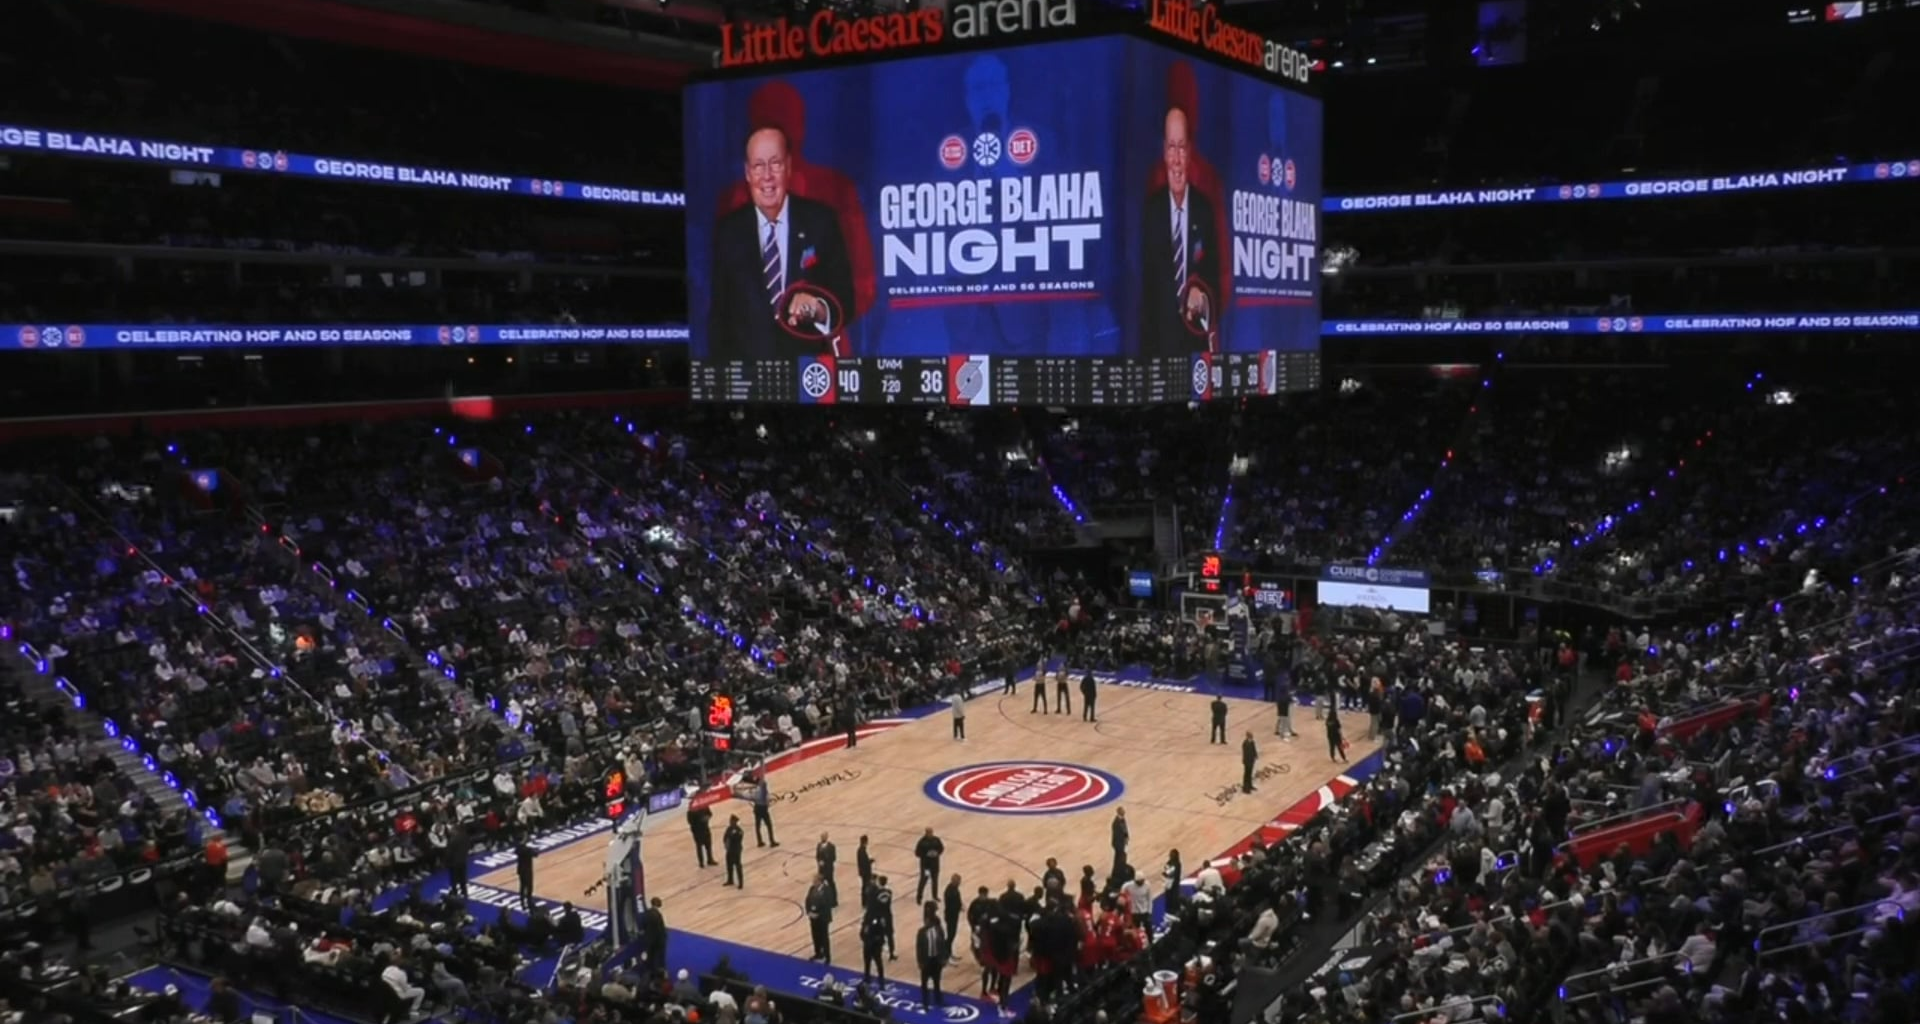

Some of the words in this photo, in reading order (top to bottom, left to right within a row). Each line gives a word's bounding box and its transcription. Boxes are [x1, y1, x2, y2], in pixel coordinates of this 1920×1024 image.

[721, 18, 805, 68] Little
[809, 8, 944, 57] Caesars
[952, 0, 1076, 39] arena
[1150, 0, 1199, 44] Little
[1201, 3, 1264, 68] Caesars
[1264, 40, 1309, 82] arena
[47, 132, 136, 157] BLAHA
[140, 141, 214, 163] NIGHT
[314, 160, 394, 180] GEORGE
[398, 167, 458, 187] BLAHA
[461, 175, 512, 192] NIGHT
[1625, 180, 1709, 196] GEORGE
[1712, 173, 1779, 191] BLAHA
[1783, 168, 1848, 185] NIGHT
[581, 185, 639, 202] GEORGE
[642, 191, 686, 206] BLAH
[880, 178, 993, 229] GEORGE
[1001, 171, 1103, 223] BLAHA
[1341, 194, 1412, 210] GEORGE
[1415, 191, 1474, 206] BLAHA
[1479, 188, 1536, 203] NIGHT
[1232, 189, 1280, 237] GEORGE
[1281, 199, 1316, 242] BLAHA
[883, 223, 1101, 277] NIGHT
[1233, 236, 1315, 281] NIGHT
[888, 285, 963, 295] CELEBRATING
[993, 282, 1016, 291] AND
[1039, 281, 1095, 291] SEASONS
[1336, 322, 1422, 333] CELEBRATING
[1424, 322, 1450, 332] HOF
[1454, 322, 1480, 332] AND
[1506, 320, 1570, 331] SEASONS
[1664, 318, 1761, 329] CELEBRATING
[1764, 317, 1795, 328] HOF
[1798, 316, 1830, 327] AND
[1853, 315, 1918, 326] SEASONS
[117, 330, 243, 343] CELEBRATING
[246, 330, 280, 342] HOF
[284, 330, 317, 342] AND
[344, 330, 412, 342] SEASONS
[499, 329, 580, 340] CELEBRATING
[582, 329, 604, 339] HOF
[606, 329, 629, 339] AND
[838, 370, 859, 393] 40
[920, 370, 943, 393] 36
[1330, 566, 1365, 578] CURE
